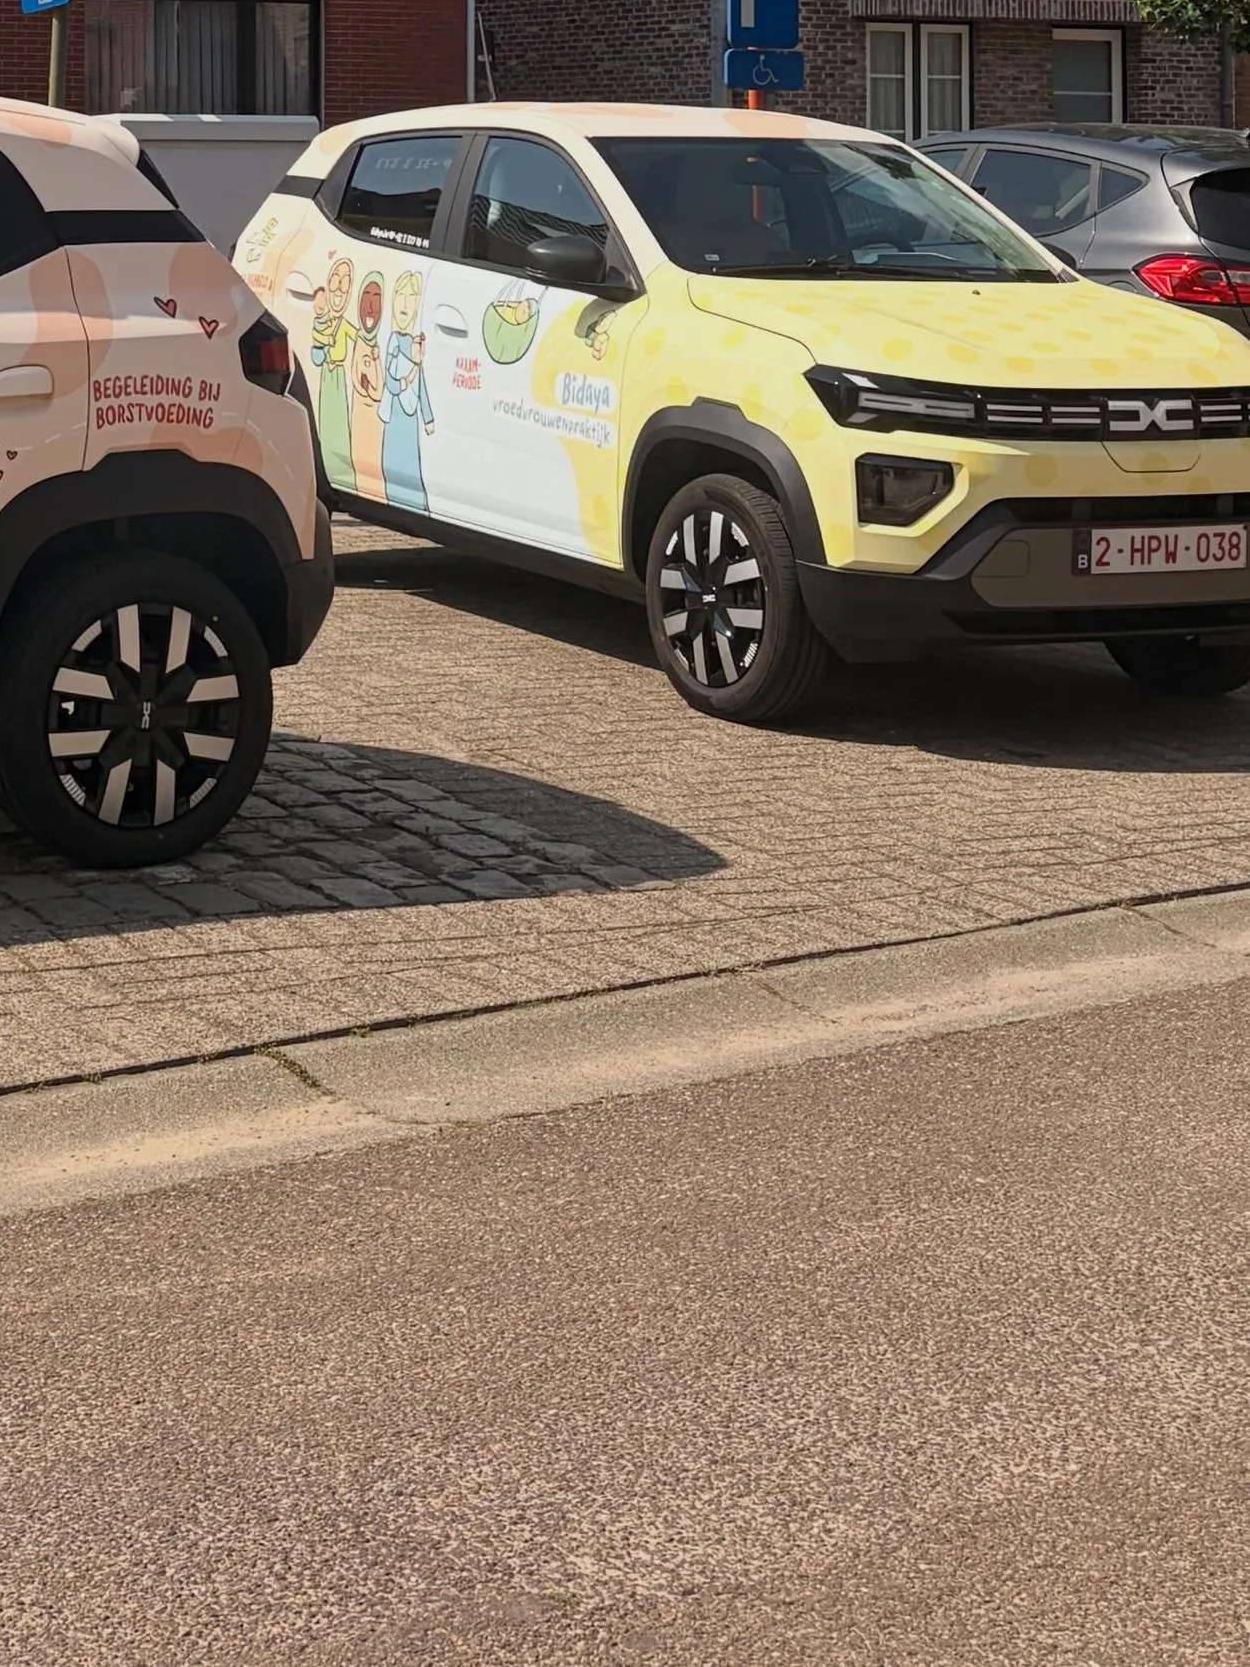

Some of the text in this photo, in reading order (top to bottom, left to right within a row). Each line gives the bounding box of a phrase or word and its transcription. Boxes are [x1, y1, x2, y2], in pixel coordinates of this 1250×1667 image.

[93, 374, 221, 402] BEGELEIDING BIJ
[561, 372, 610, 415] Bidaya
[96, 402, 214, 430] BORSTVOEDING
[492, 398, 611, 448] vroedvrouwenpraktijk
[1077, 531, 1241, 569] B 2-HPW-038
